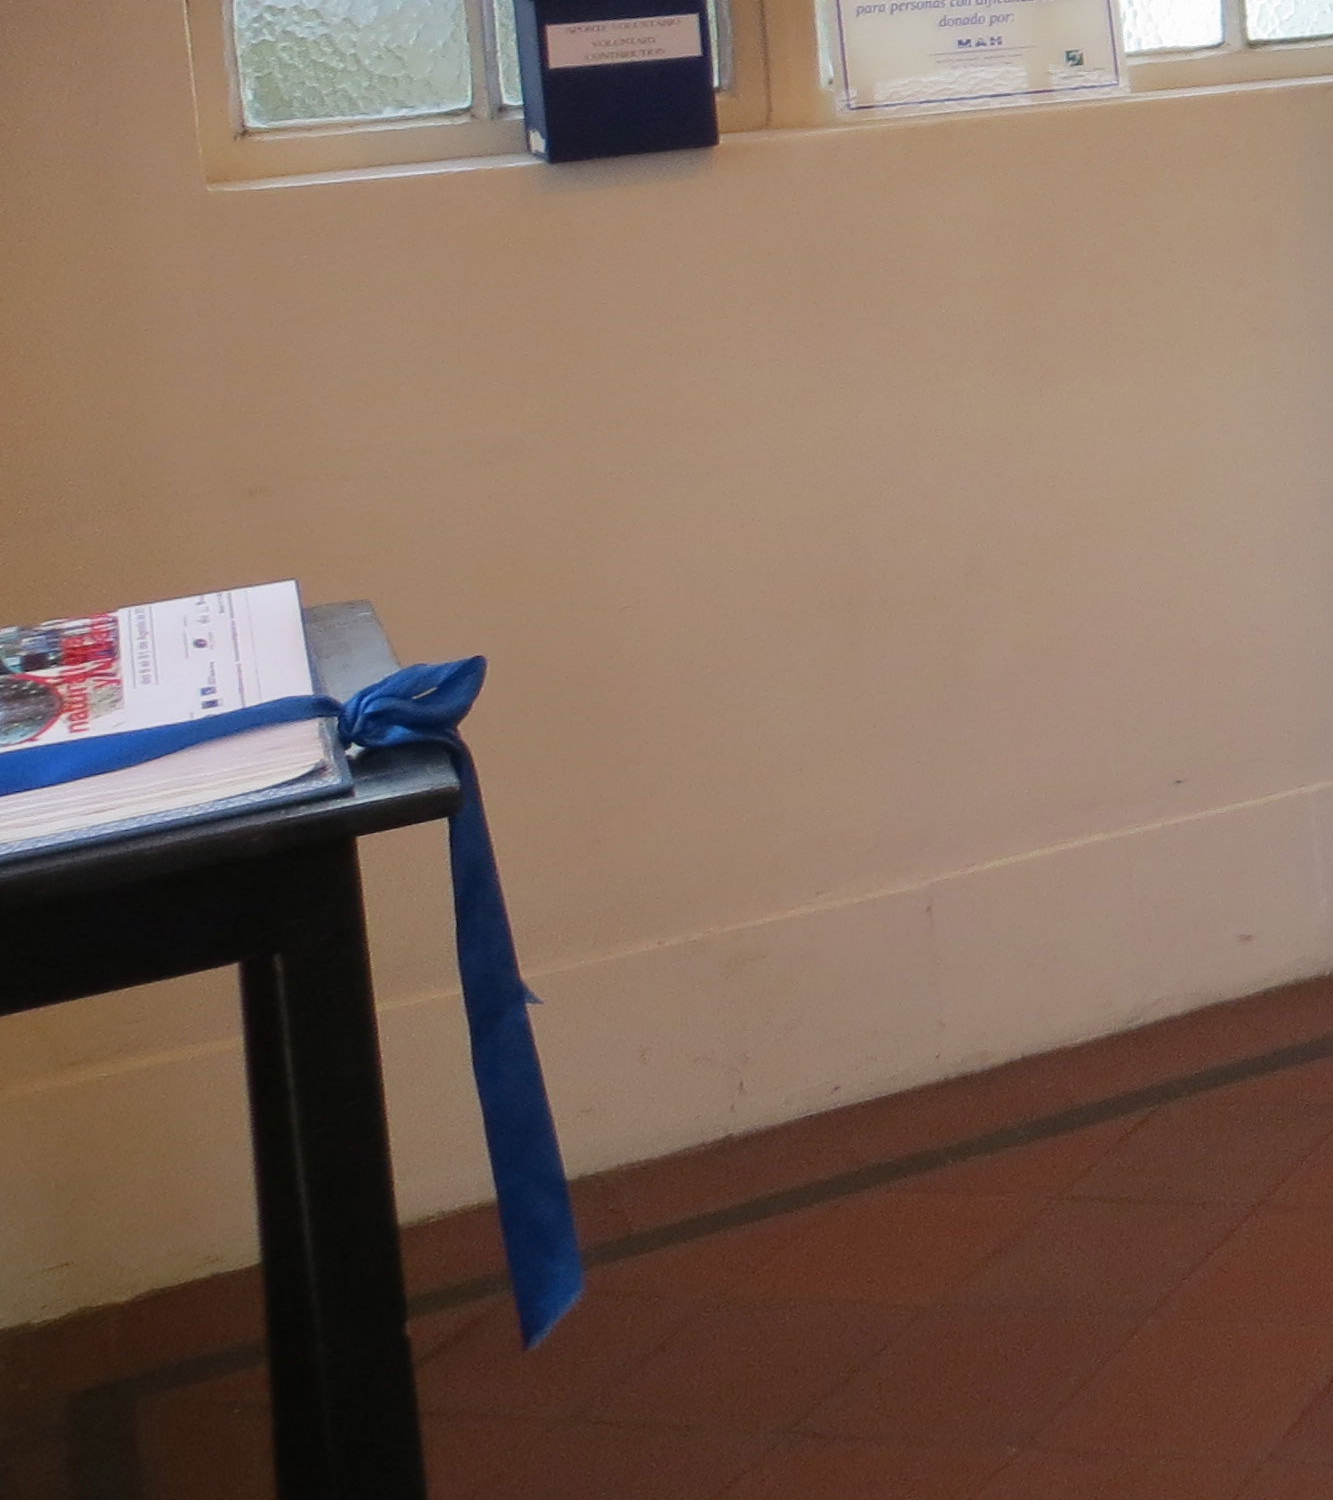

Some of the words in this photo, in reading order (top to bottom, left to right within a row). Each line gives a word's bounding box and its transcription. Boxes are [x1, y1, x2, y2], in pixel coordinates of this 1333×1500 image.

[856, 2, 886, 17] para
[890, 0, 946, 15] personas
[939, 13, 987, 27] donado
